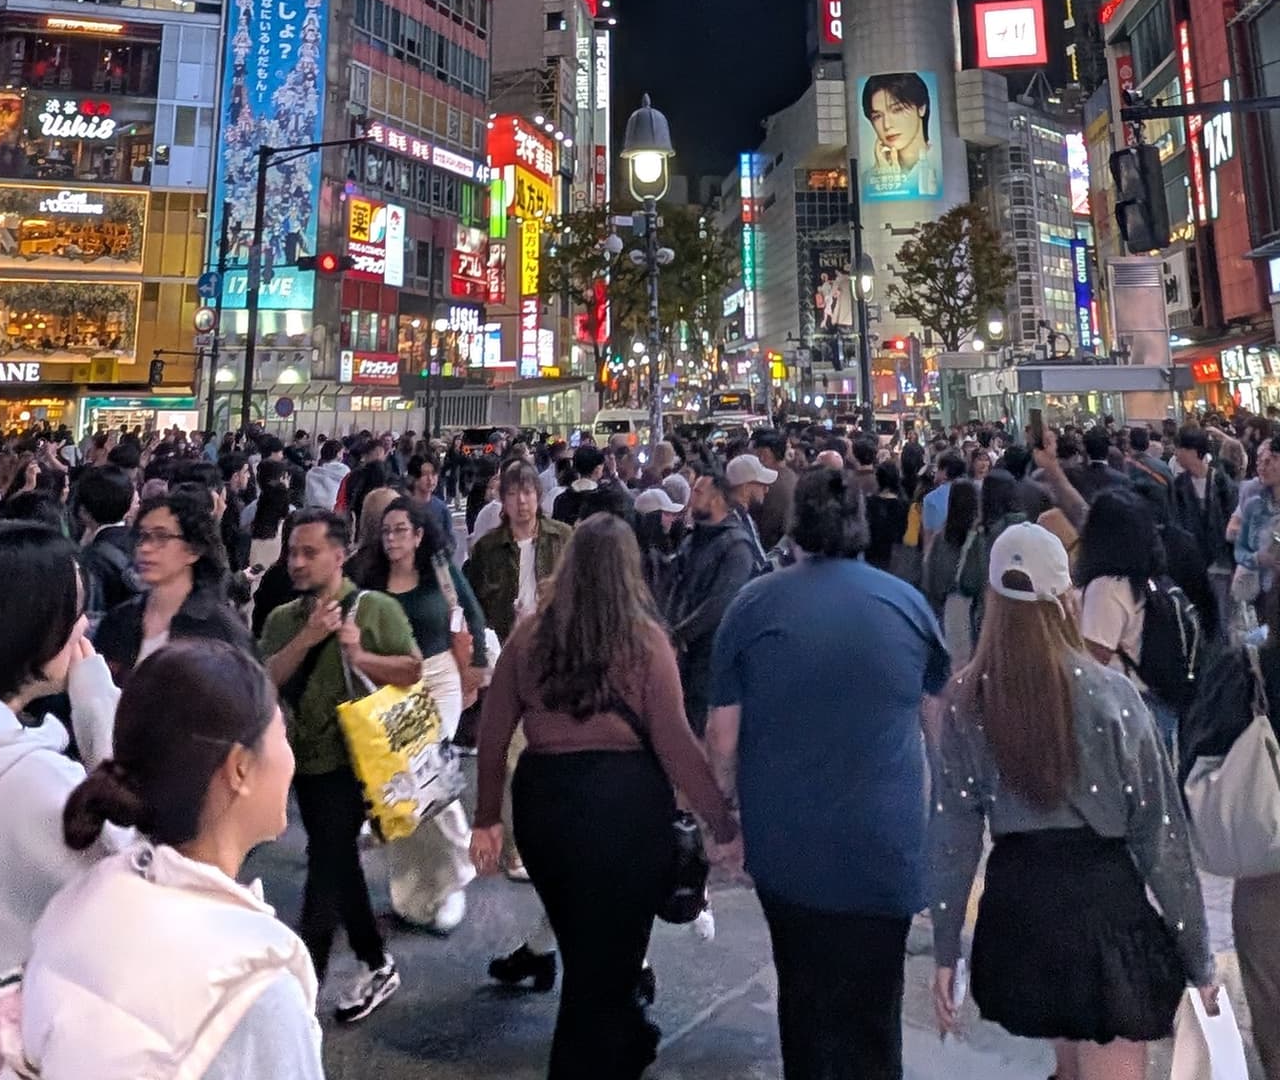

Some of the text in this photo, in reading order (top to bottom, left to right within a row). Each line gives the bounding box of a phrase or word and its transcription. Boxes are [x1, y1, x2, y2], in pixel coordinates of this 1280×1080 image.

[45, 99, 78, 115] 渋谷
[38, 112, 116, 140] Ushi8
[476, 164, 491, 183] 4F
[350, 203, 371, 239] 薬
[458, 254, 483, 277] アコム
[1075, 246, 1088, 283] MIZUHO
[228, 276, 294, 296] 17IVE
[448, 305, 480, 334] USH
